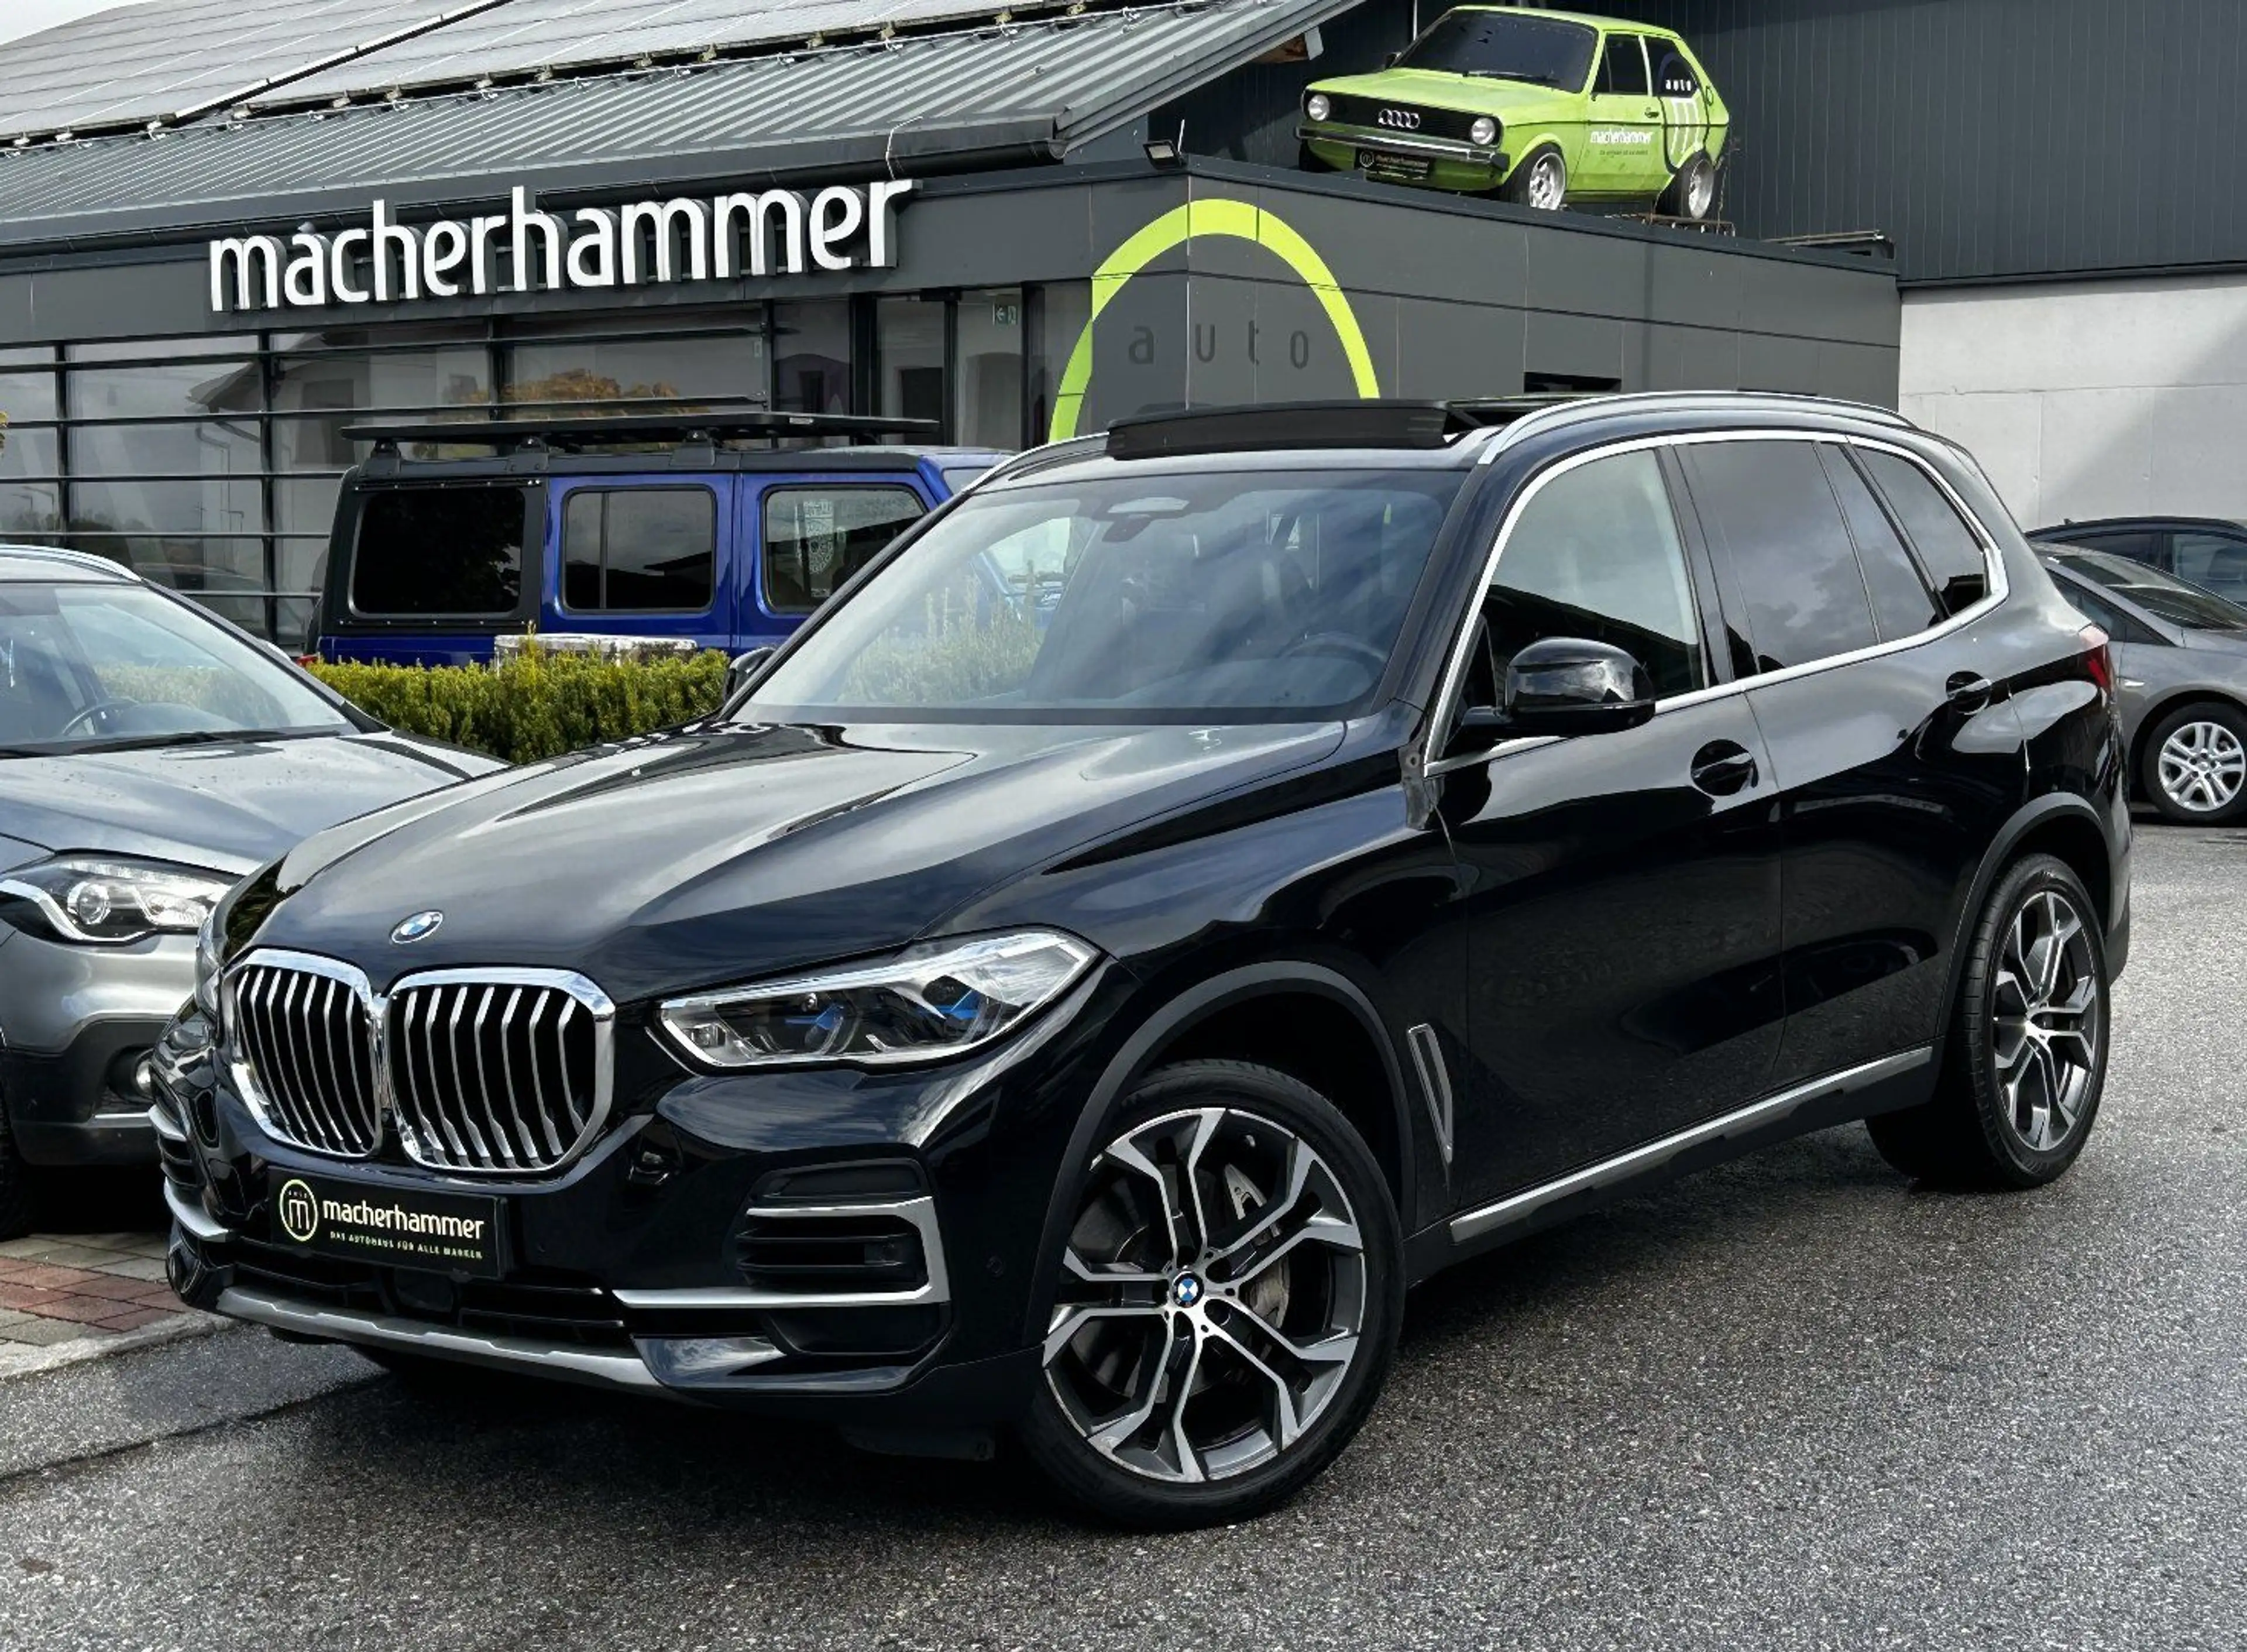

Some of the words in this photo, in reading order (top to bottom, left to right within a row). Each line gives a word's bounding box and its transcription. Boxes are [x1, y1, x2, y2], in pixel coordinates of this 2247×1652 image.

[210, 179, 914, 311] macherhammer
[1129, 320, 1309, 370] auto
[323, 1200, 485, 1239] macherhammer
[330, 1231, 346, 1242] DAS
[349, 1235, 394, 1248] AUTOHAUS
[417, 1244, 439, 1254] ALLE
